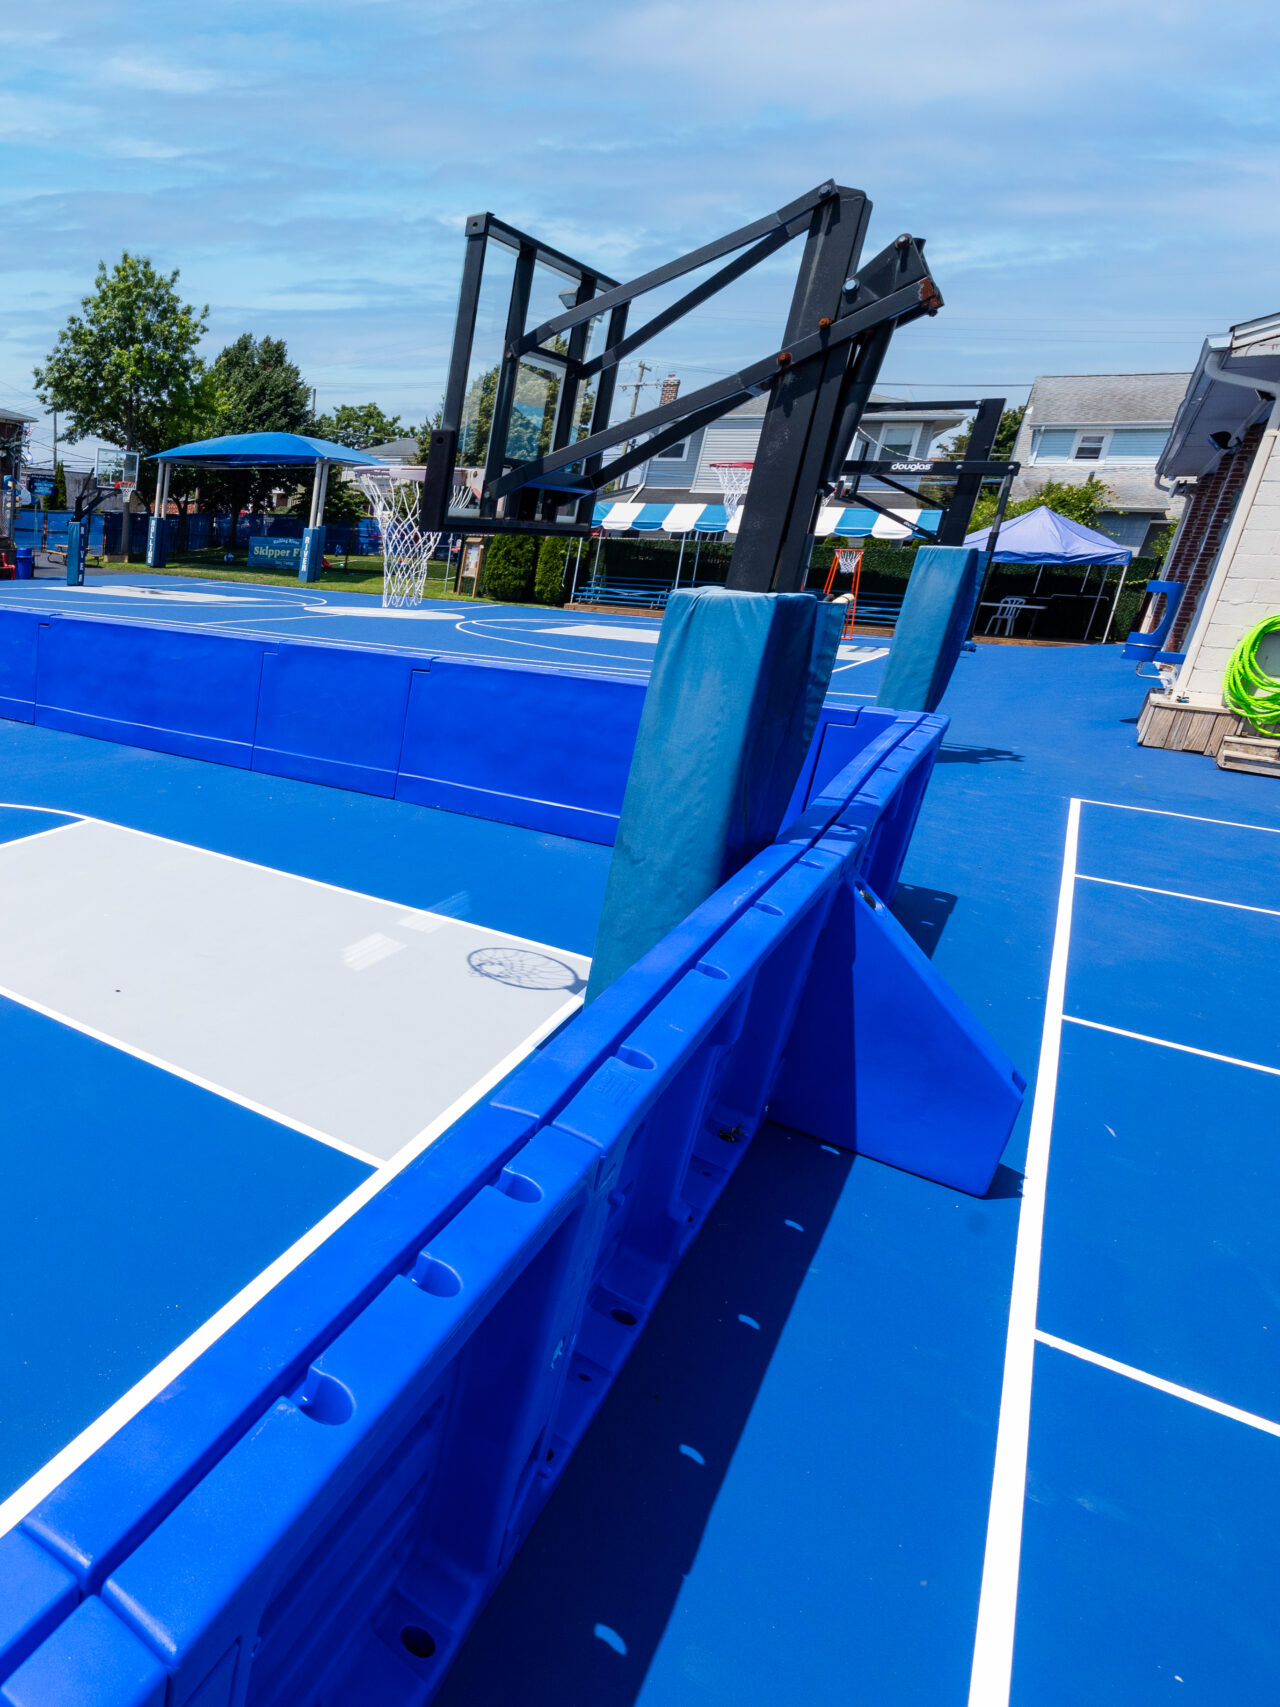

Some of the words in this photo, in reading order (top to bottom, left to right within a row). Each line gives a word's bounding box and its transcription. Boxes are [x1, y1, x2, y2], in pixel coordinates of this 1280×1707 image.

[891, 462, 933, 471] douglas
[253, 546, 291, 558] Skipper
[301, 536, 310, 572] RIVER
